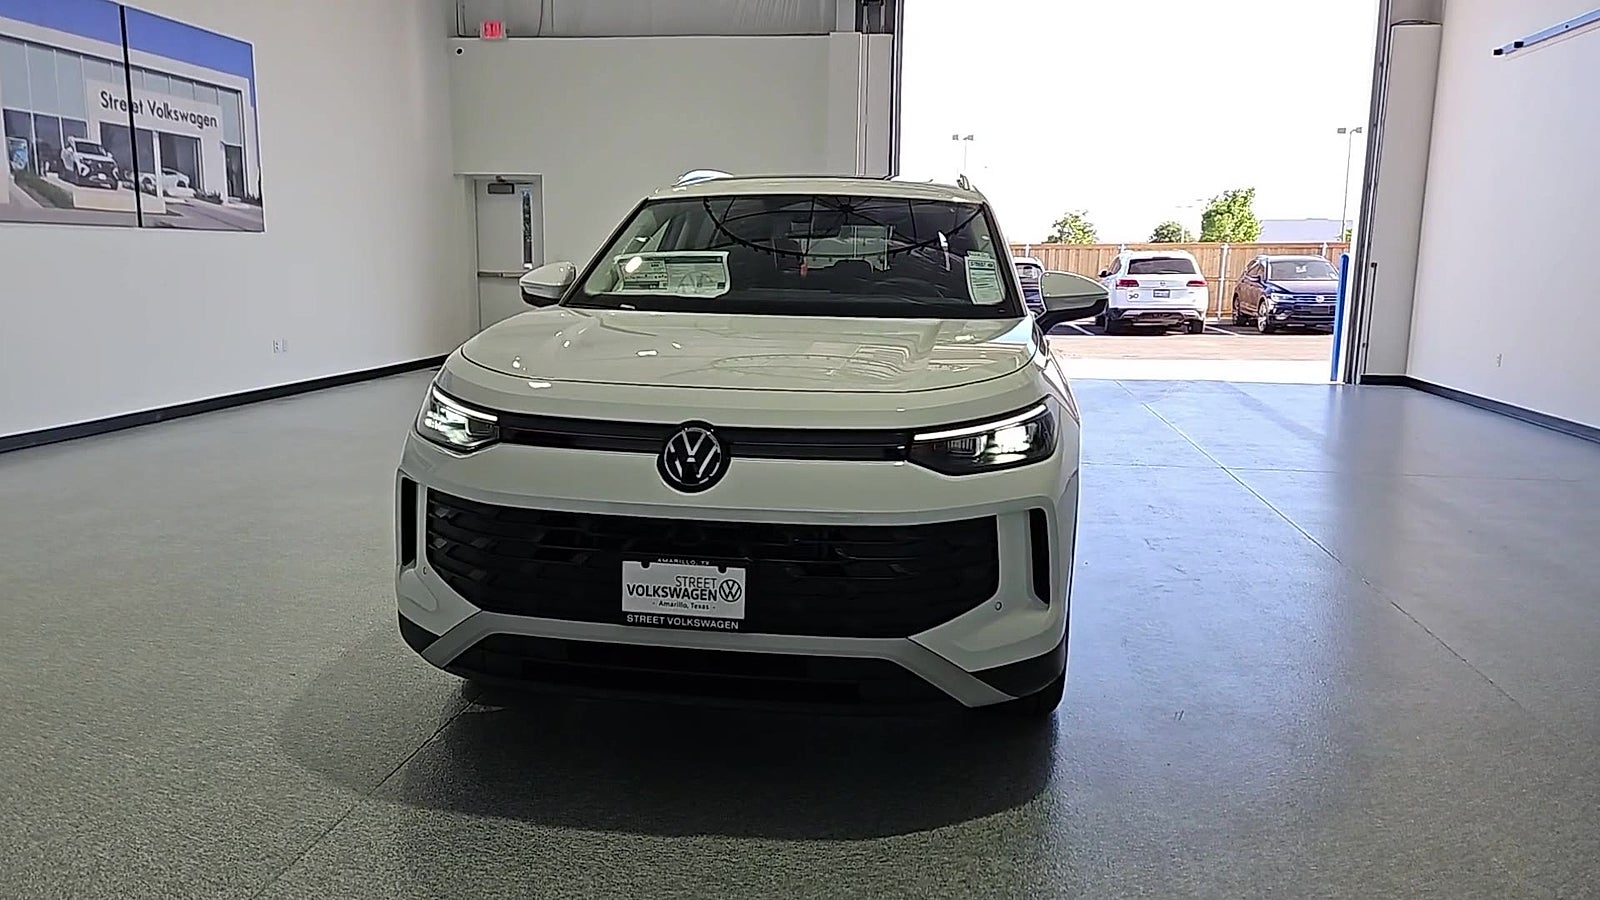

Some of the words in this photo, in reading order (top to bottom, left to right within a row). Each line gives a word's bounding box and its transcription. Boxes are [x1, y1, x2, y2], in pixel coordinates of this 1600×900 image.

[100, 90, 144, 115] Street
[147, 100, 218, 130] Volkswagen
[675, 575, 718, 589] STREET
[627, 583, 718, 602] VOLKSWAGEN
[690, 602, 710, 610] Texas
[627, 614, 665, 625] STREET
[667, 616, 739, 630] VOLKSWAGEN
